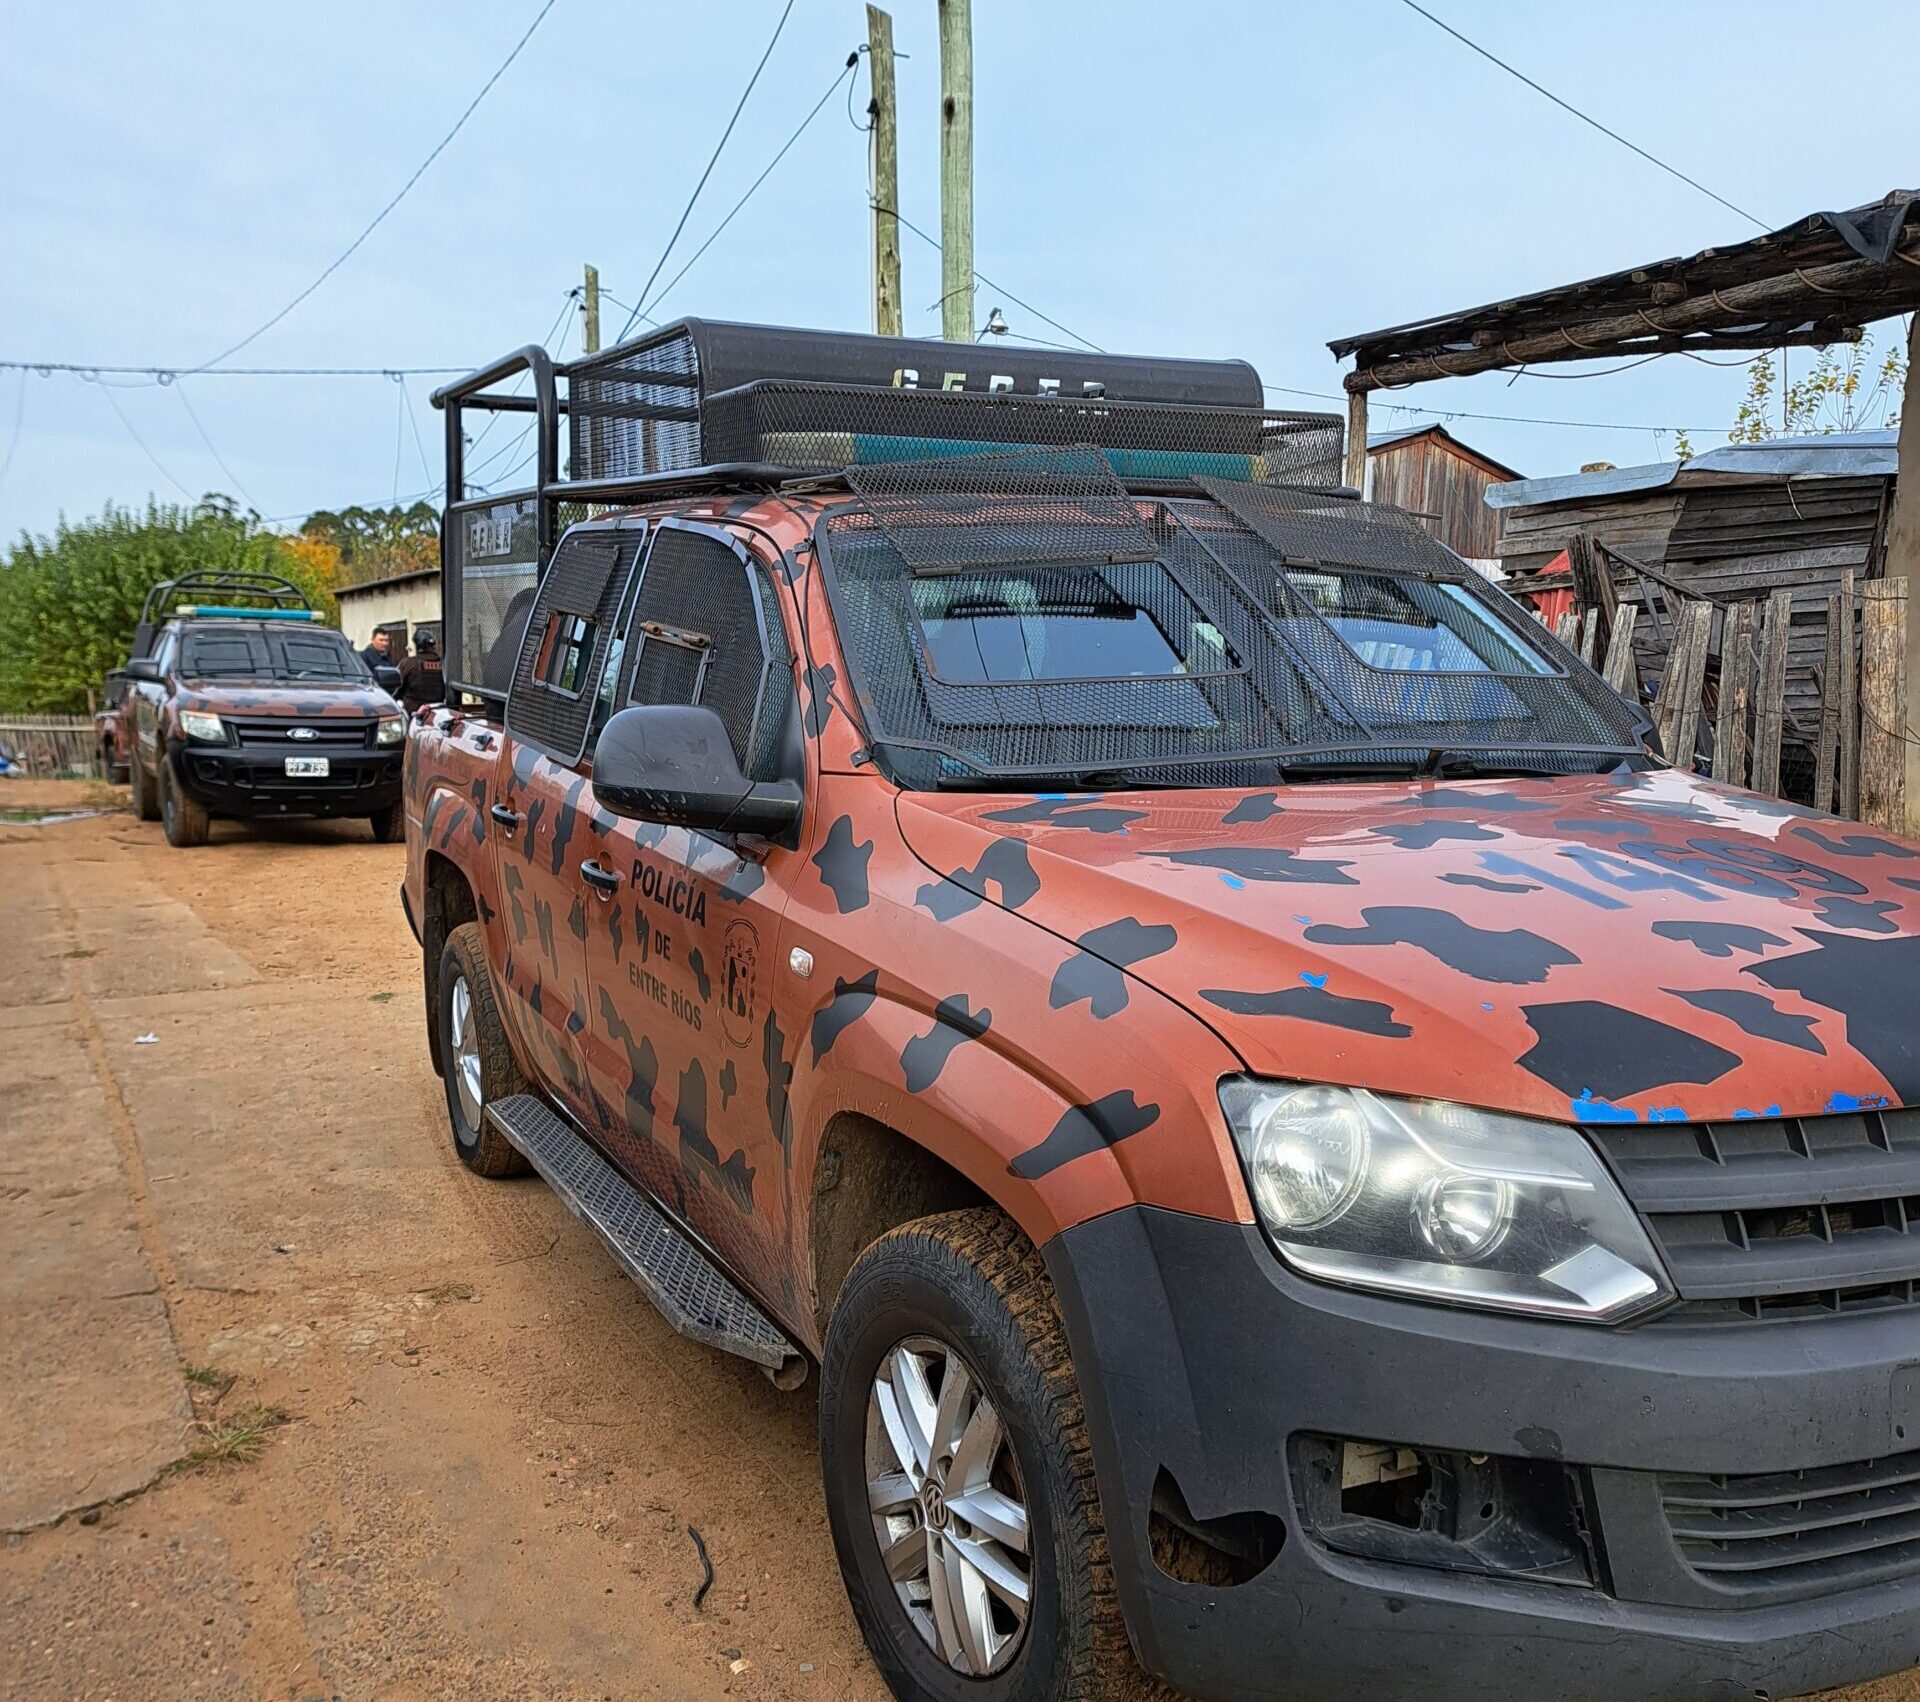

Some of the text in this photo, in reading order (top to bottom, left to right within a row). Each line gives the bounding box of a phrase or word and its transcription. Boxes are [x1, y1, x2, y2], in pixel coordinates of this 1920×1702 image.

[631, 859, 706, 928] POLICÍA
[1474, 838, 1868, 911] 1469
[654, 929, 671, 962] DE
[629, 961, 702, 1032] ENTRE RÍOS
